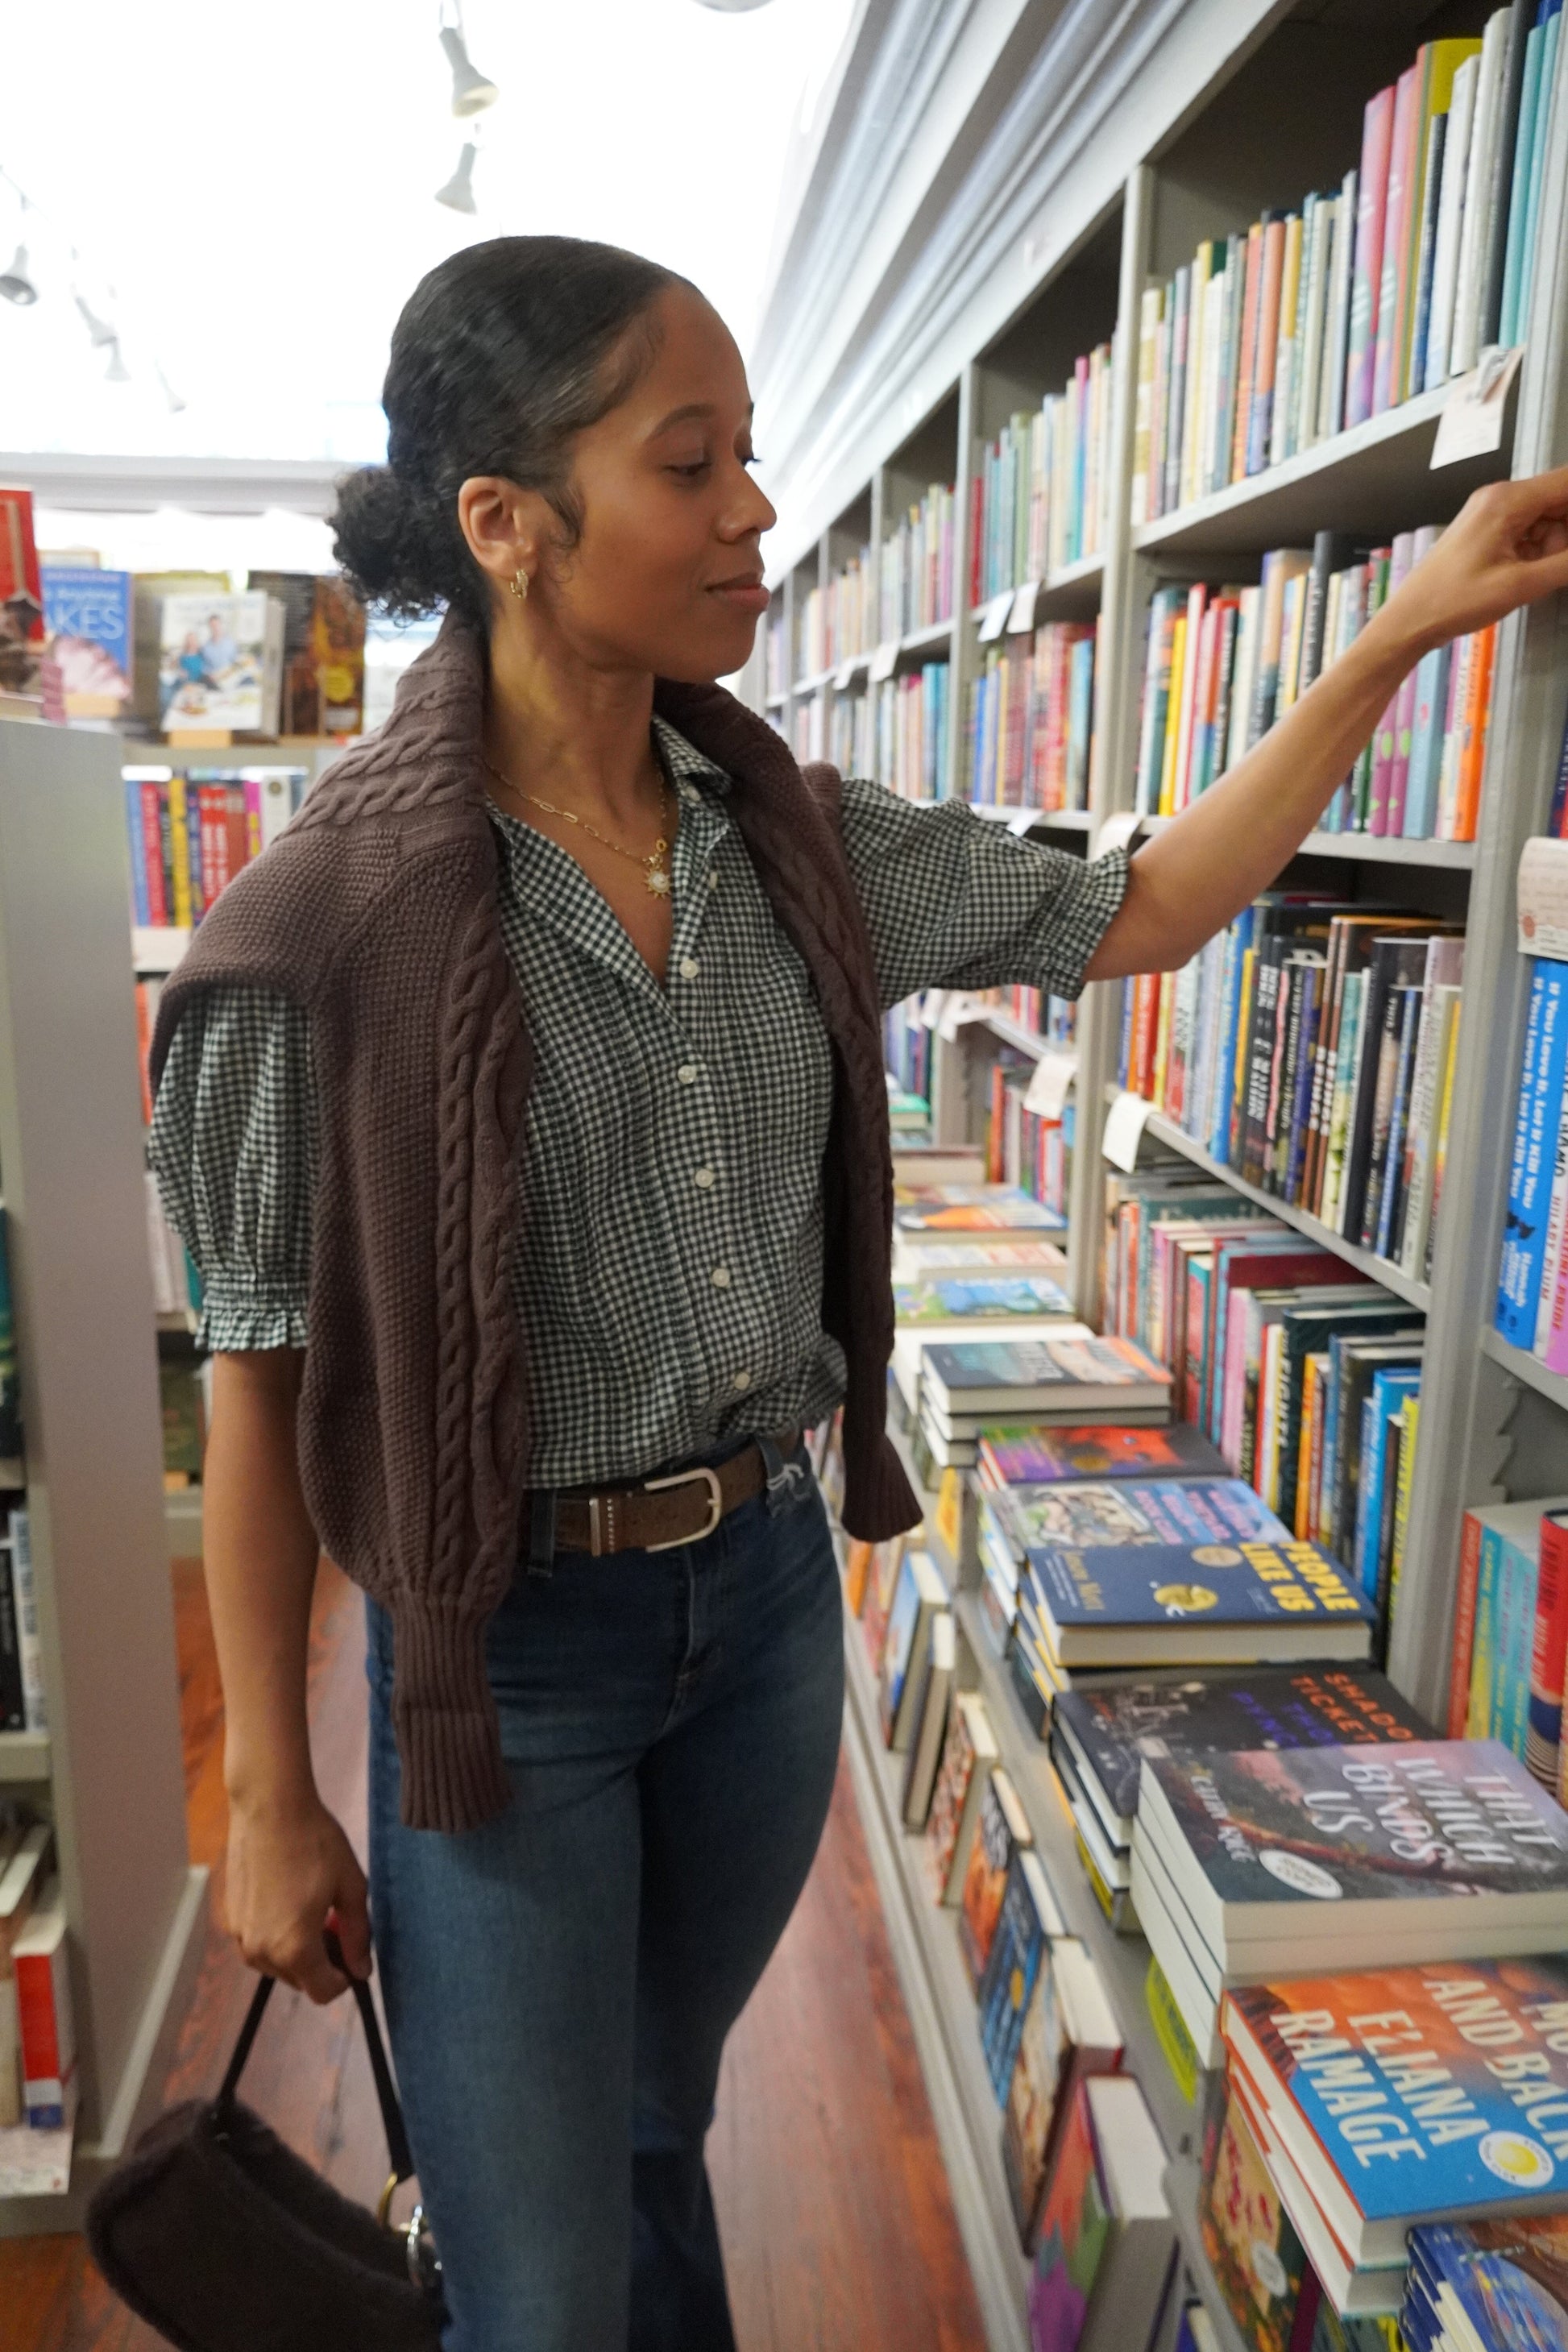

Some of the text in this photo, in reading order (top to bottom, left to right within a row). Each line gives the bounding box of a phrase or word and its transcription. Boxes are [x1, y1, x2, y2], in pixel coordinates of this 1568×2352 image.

[1528, 993, 1542, 1027] You
[1544, 999, 1559, 1033] You
[1524, 1029, 1538, 1070] Love
[1538, 1035, 1554, 1077] Love
[1519, 1091, 1532, 1118] Let
[1533, 1099, 1546, 1126] Let
[1513, 1135, 1527, 1165] Kill
[1527, 1143, 1541, 1174] Kill
[1509, 1167, 1524, 1199] You
[1522, 1176, 1538, 1209] You
[1541, 1256, 1554, 1300] PLUM
[1239, 1542, 1294, 1582] LIKE
[1269, 1584, 1317, 1611] US
[1278, 1542, 1361, 1611] PEOPLE
[1291, 1674, 1380, 1743] TICKET
[1324, 1672, 1415, 1741] SHADO
[1302, 1790, 1374, 1834] US
[1342, 1762, 1452, 1861] BINDS
[1395, 1757, 1516, 1865] WHICH
[1462, 1765, 1568, 1852] THAT
[1269, 2009, 1427, 2168] RAMAGE
[1346, 2010, 1491, 2147] ELIANA
[1422, 1980, 1524, 2046] AND
[1483, 2051, 1568, 2163] BACK
